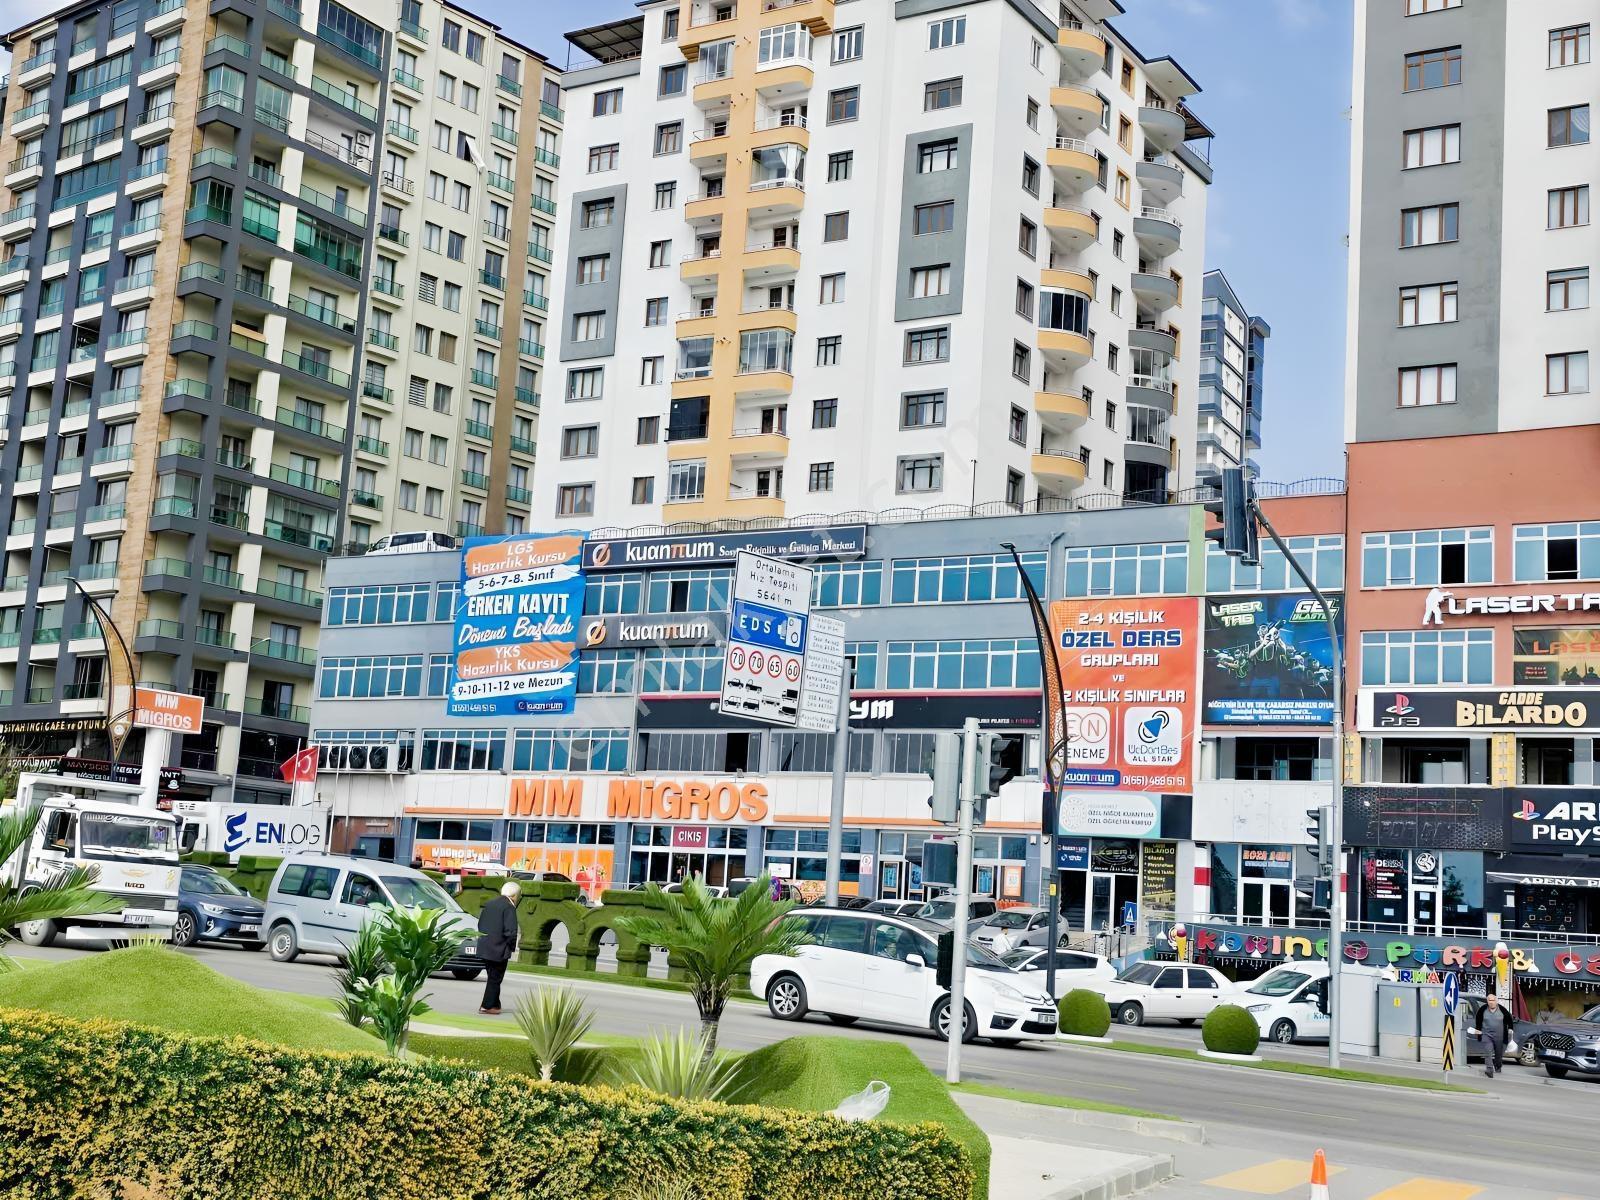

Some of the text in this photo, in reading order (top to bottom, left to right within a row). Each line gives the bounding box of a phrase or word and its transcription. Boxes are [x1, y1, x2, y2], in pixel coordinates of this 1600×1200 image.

[507, 542, 534, 555] LGS
[719, 546, 738, 558] Sosy
[472, 550, 566, 575] Hazırlık Kursu
[756, 560, 796, 580] Ortalama
[528, 569, 555, 583] Sınıf
[769, 576, 799, 592] Tespiti
[467, 593, 570, 617] ERKEN KAYIT
[785, 598, 792, 606] m
[1449, 595, 1555, 615] LASER
[739, 614, 771, 634] EDS
[1078, 609, 1165, 627] 2-4 KİŞİLİK
[1222, 613, 1254, 627] TAG
[513, 614, 574, 643] Başladı
[1061, 628, 1182, 650] ÖZEL DERS
[495, 645, 521, 659] YKS
[732, 652, 743, 667] 70
[463, 657, 560, 677] Hazırlık Kursu
[750, 655, 762, 670] 70
[769, 661, 780, 673] 65
[787, 665, 798, 677] 60
[1112, 674, 1125, 683] VE
[513, 682, 525, 690] ve
[528, 677, 563, 689] Mezun
[155, 693, 179, 708] MM
[1075, 688, 1120, 705] KİŞİLİK
[1124, 689, 1186, 704] SINIFLAR
[77, 719, 100, 730] OYUN
[1381, 716, 1420, 726] PS3
[509, 779, 584, 817] MM
[1543, 802, 1600, 821] AR
